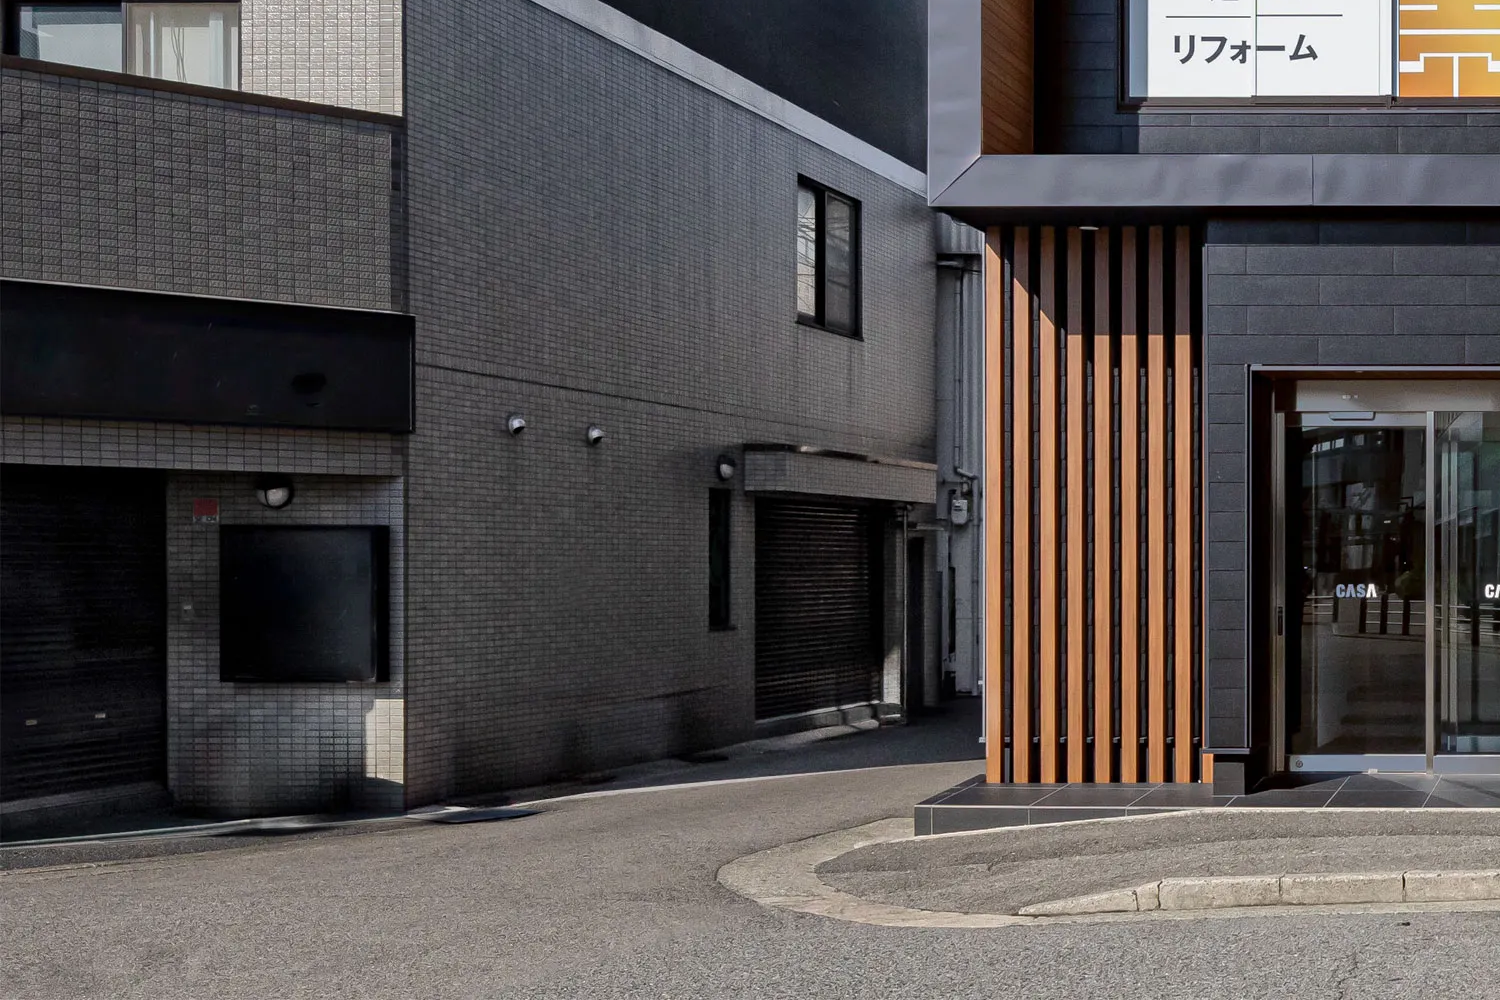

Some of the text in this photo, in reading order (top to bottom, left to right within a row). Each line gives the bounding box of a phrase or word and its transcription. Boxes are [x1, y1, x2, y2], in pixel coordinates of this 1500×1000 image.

[1173, 34, 1319, 65] リフォーム
[1336, 584, 1378, 598] CASA
